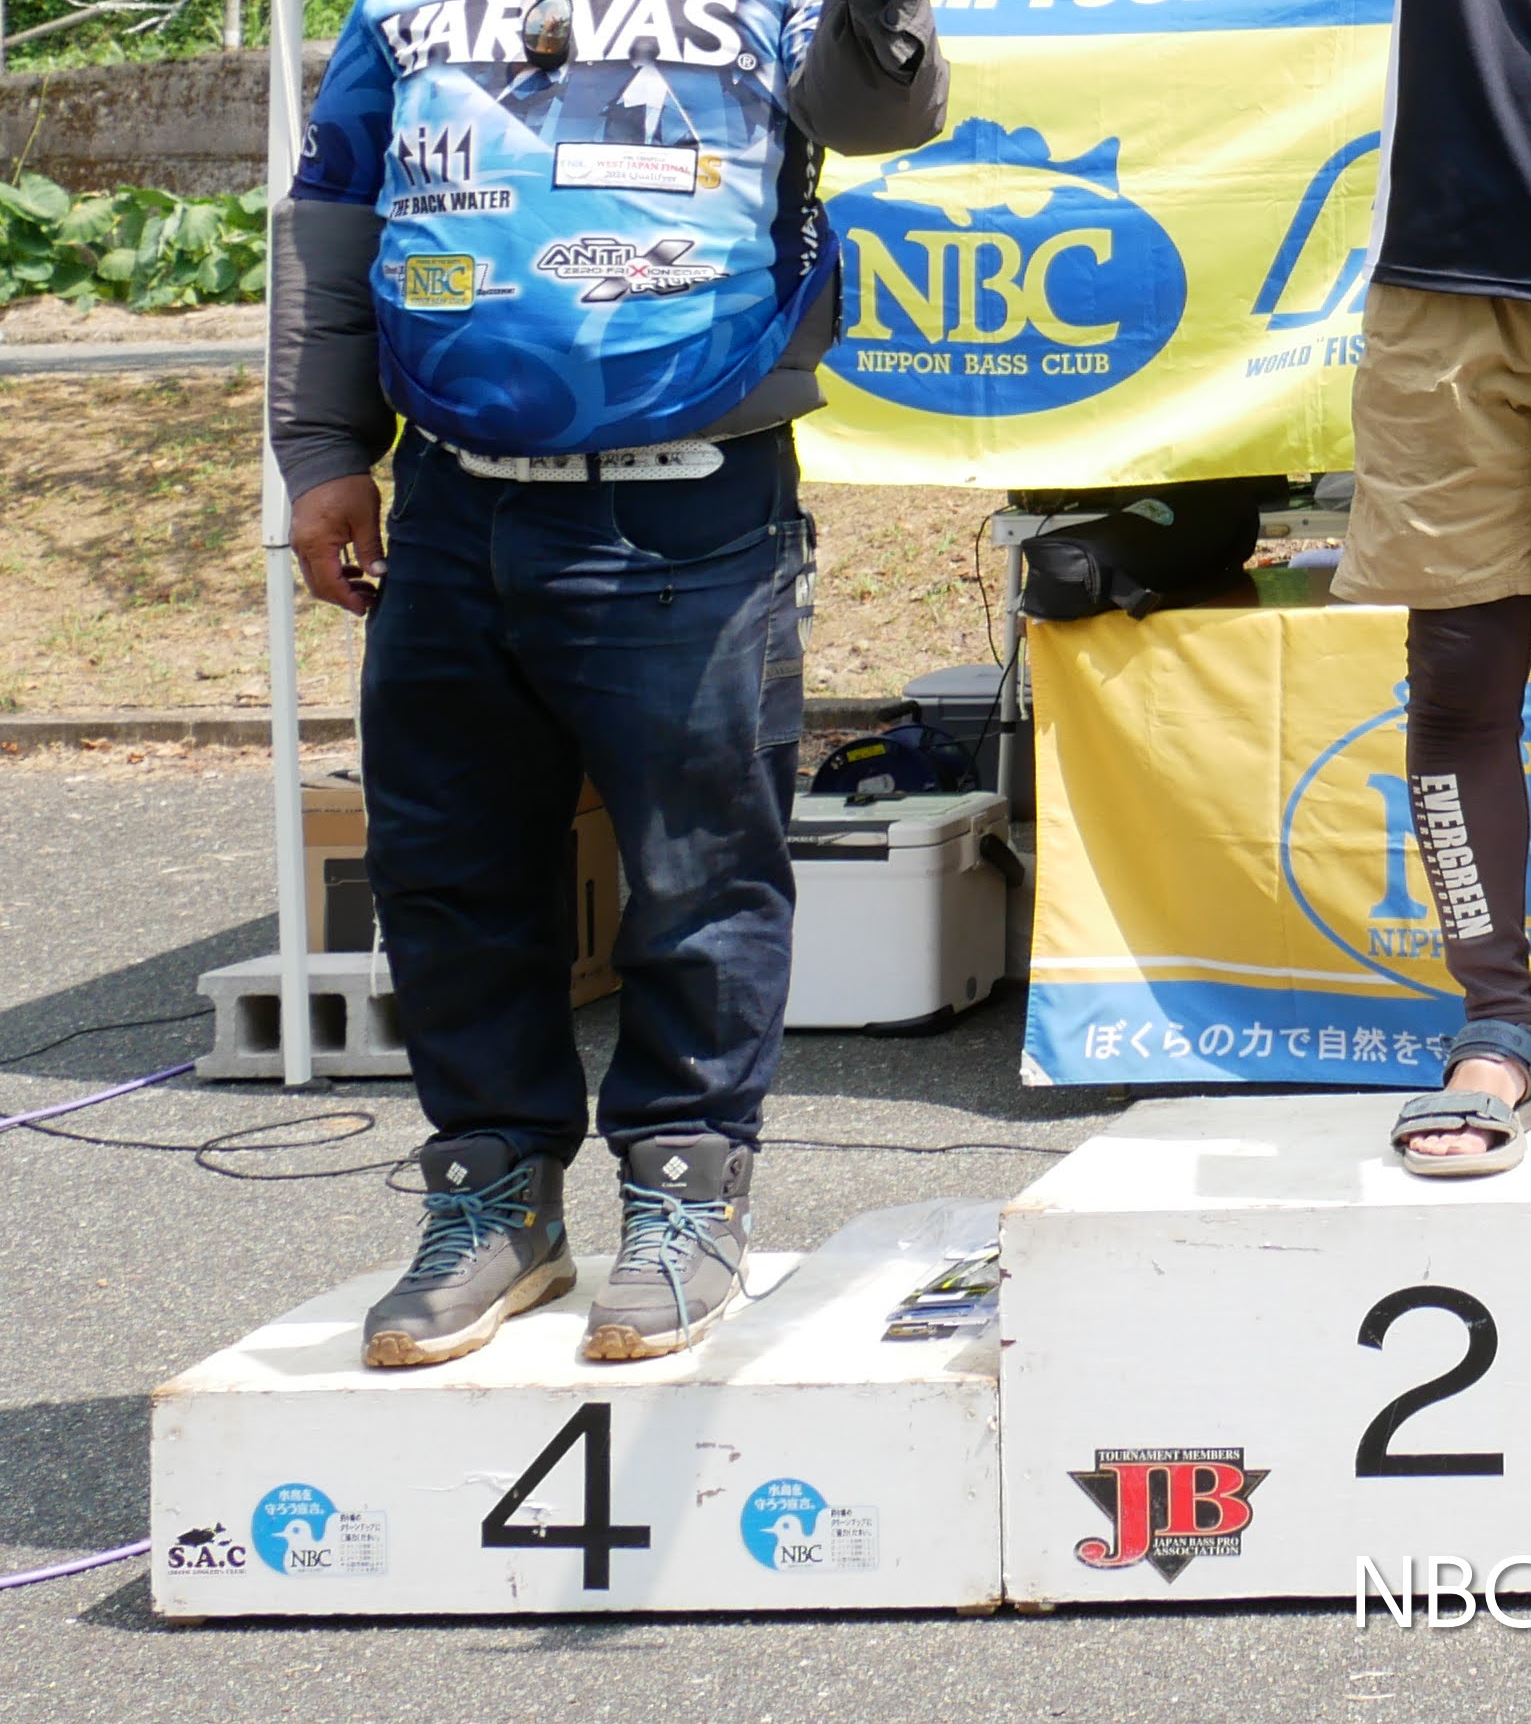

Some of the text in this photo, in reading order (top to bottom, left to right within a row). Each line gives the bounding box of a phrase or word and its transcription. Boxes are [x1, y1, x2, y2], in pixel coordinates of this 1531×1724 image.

[597, 160, 691, 175] WEST JAPAN FINAL
[390, 190, 510, 218] THE BACK WATER
[411, 265, 466, 295] NBC
[845, 227, 1121, 348] NBC
[857, 350, 1110, 375] NIPPON BASS CLUB
[1246, 345, 1312, 378] WORLD
[1421, 774, 1493, 940] EVERGREEN
[1356, 1285, 1504, 1477] 2
[1098, 1449, 1241, 1461] TOURNAMENT MEMBERS
[480, 1402, 651, 1591] 4
[1079, 1463, 1250, 1566] JB
[781, 1544, 823, 1563] NBC
[1153, 1538, 1239, 1547] JAPAN BASS PRO
[1153, 1547, 1239, 1556] ASSOCIATION
[168, 1546, 247, 1568] S.A.C
[291, 1549, 332, 1568] NBC
